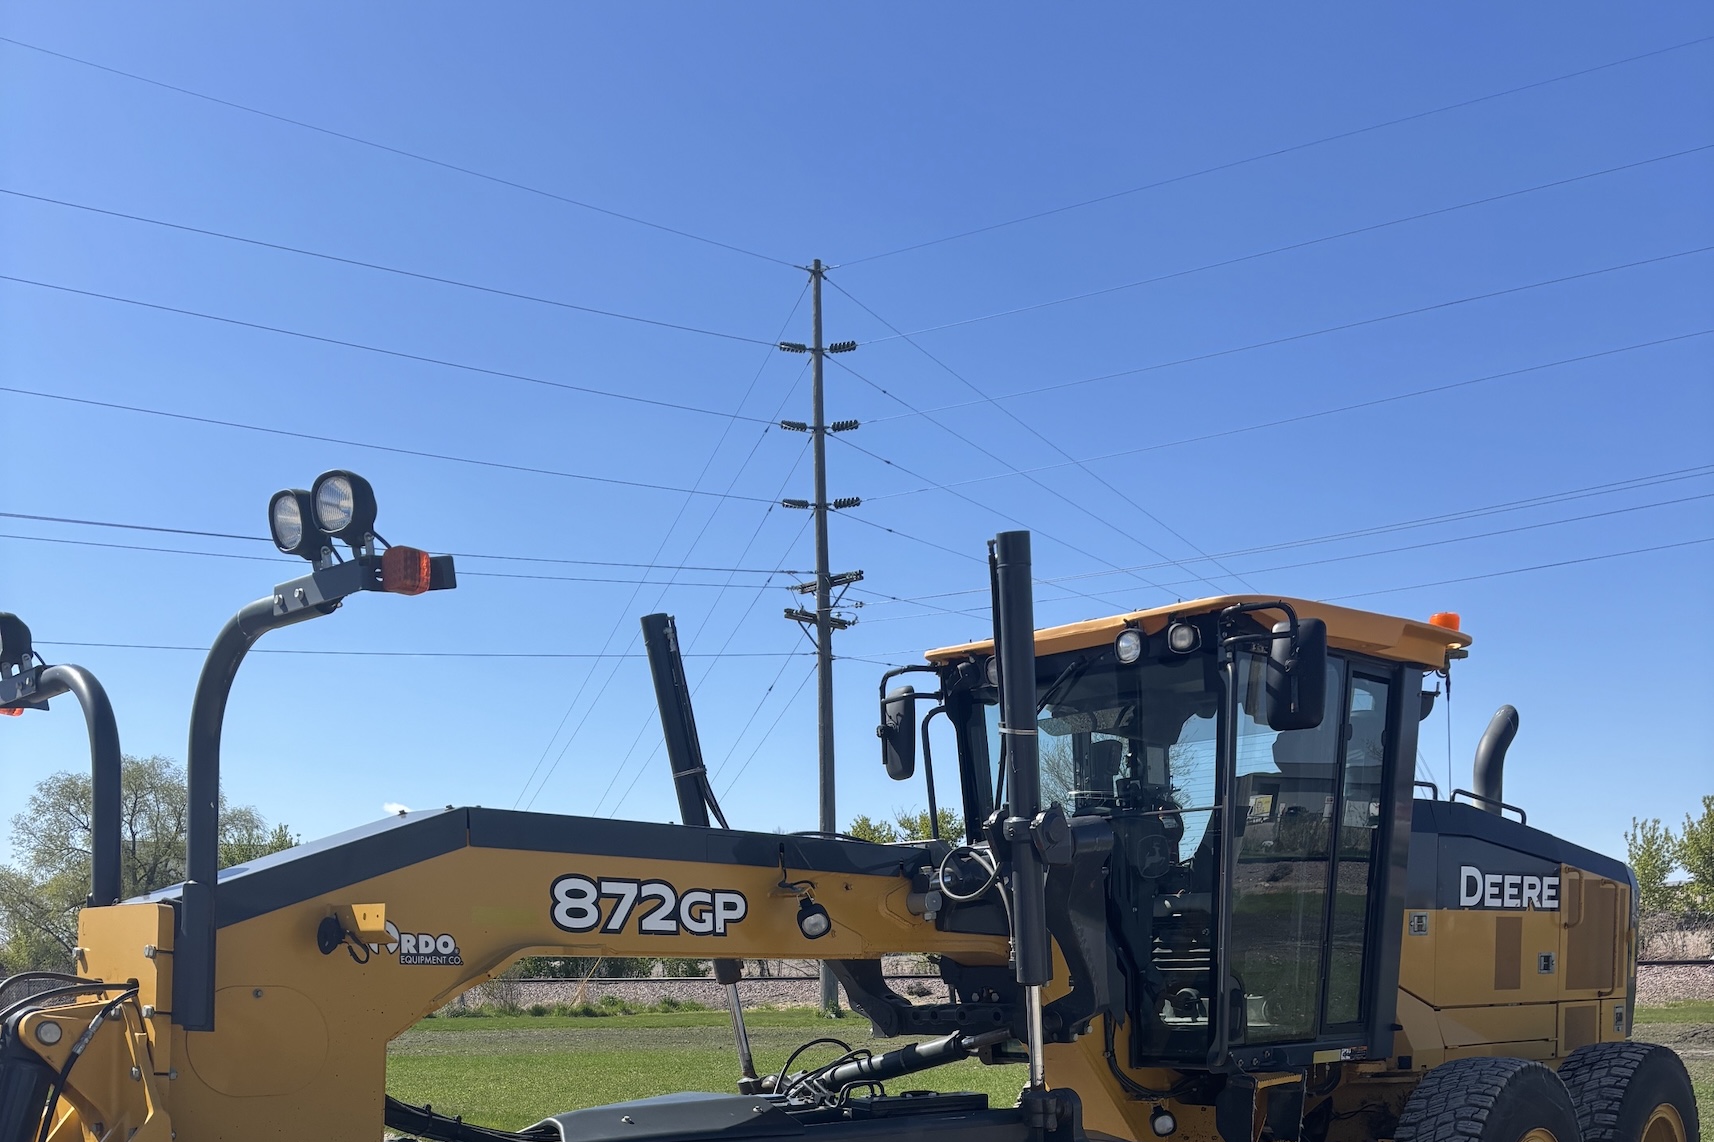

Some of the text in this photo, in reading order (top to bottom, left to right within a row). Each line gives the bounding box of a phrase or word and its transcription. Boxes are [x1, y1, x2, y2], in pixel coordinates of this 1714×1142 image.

[1460, 865, 1560, 908] DEERE
[551, 875, 747, 934] 872GP
[400, 933, 456, 954] RDO
[400, 955, 463, 965] EQUIPMENT CO.
